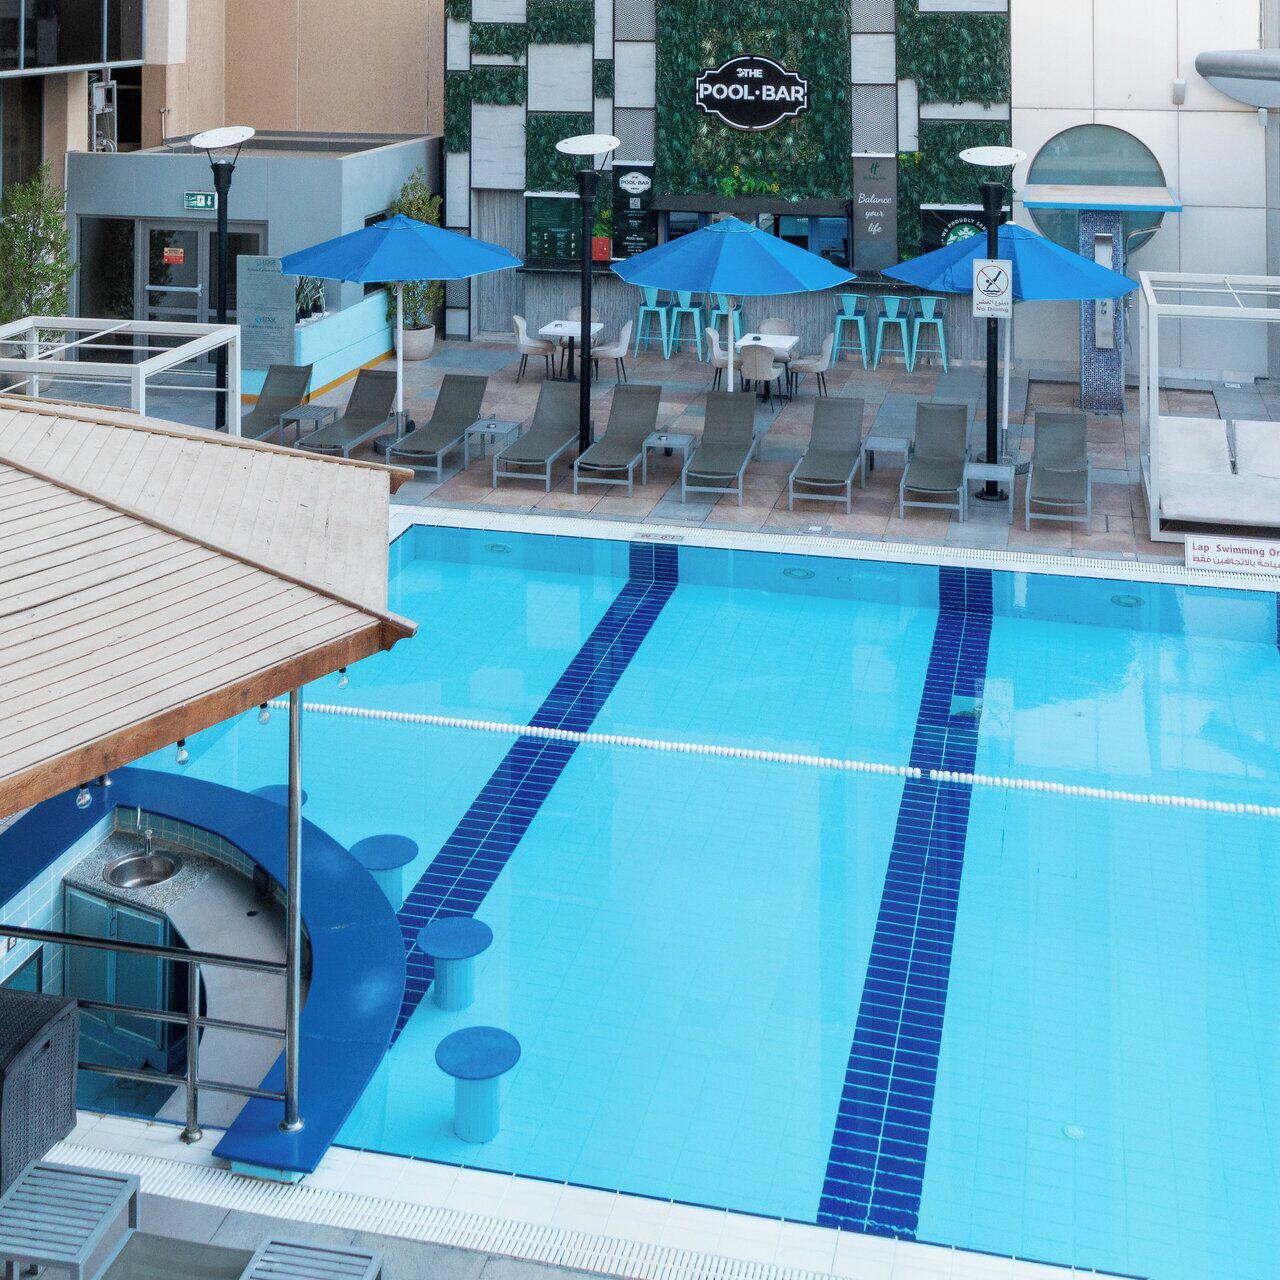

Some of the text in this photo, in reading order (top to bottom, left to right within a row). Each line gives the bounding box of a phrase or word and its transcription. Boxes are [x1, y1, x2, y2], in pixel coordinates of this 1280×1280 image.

[745, 69, 763, 78] THE
[700, 83, 804, 101] POOL BAR
[858, 192, 892, 204] Balance
[865, 210, 884, 219] your
[868, 223, 882, 235] life
[941, 228, 948, 237] WE
[947, 217, 975, 229] PROUDLY
[1192, 543, 1210, 553] Lap
[1216, 544, 1265, 557] Swimming
